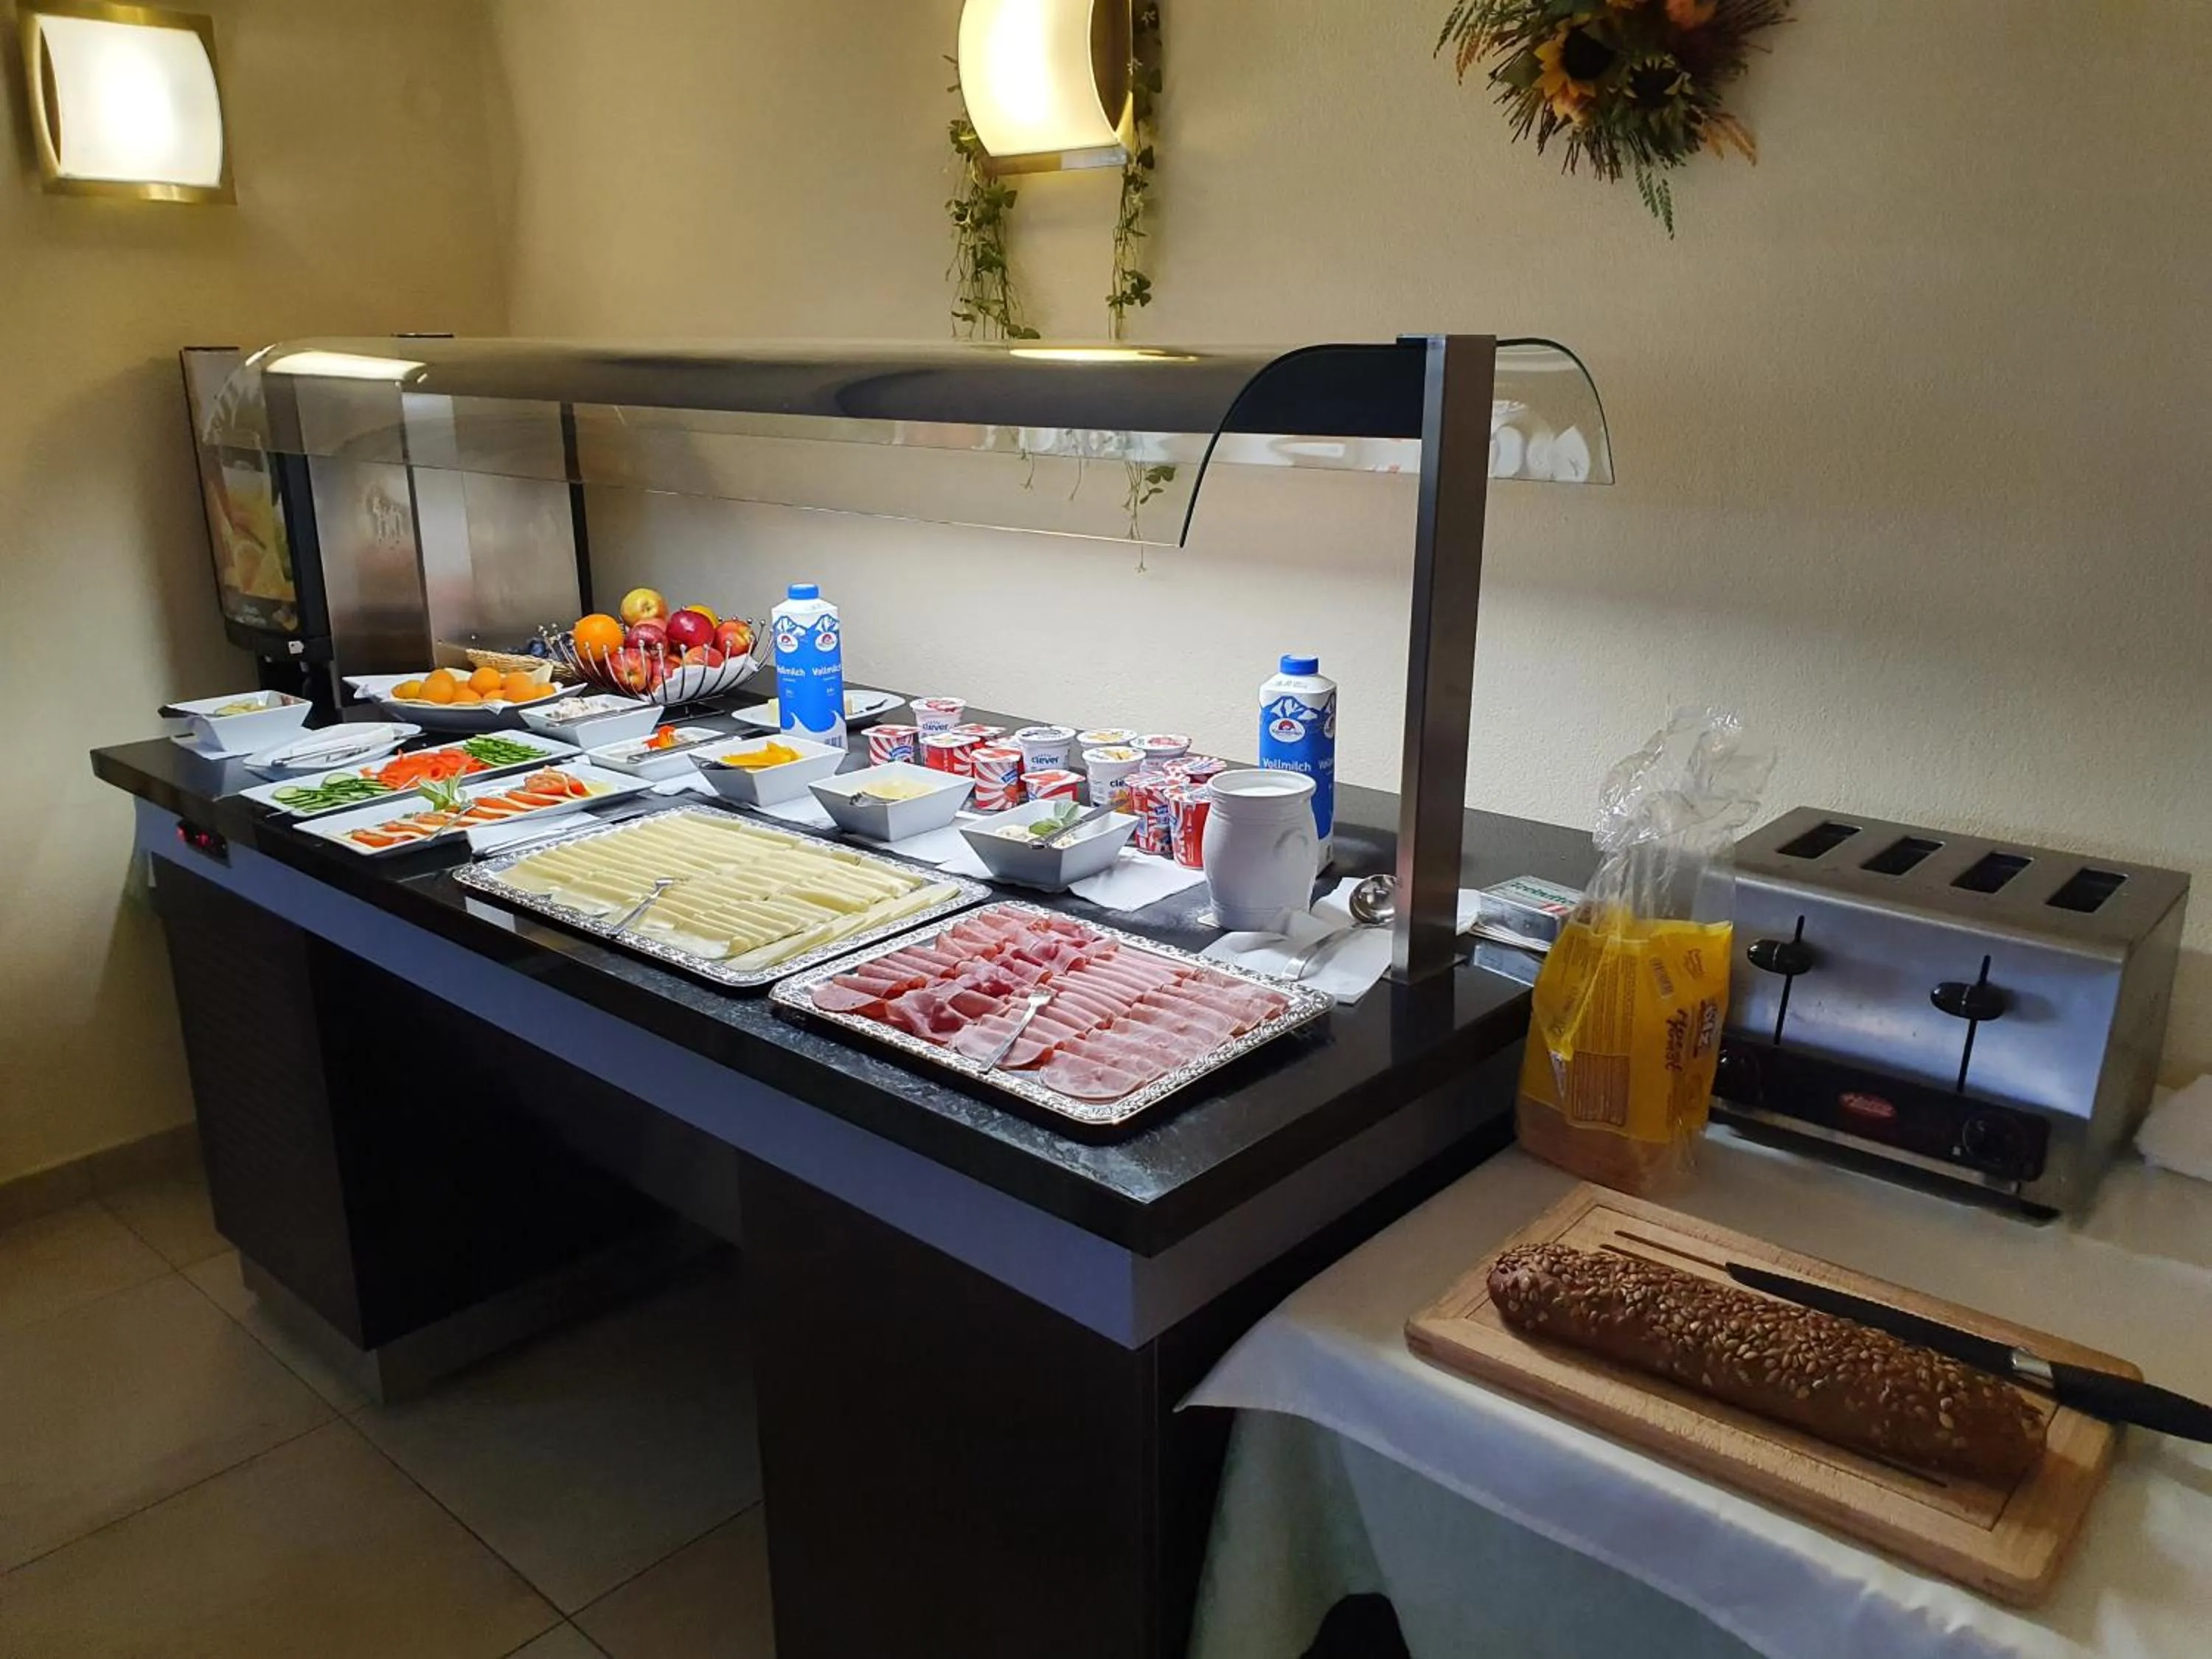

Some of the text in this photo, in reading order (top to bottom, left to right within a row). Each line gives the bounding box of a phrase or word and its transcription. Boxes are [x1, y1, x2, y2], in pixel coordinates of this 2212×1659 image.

[1032, 757, 1059, 765] clever
[1262, 757, 1312, 772] Vollmilch
[1110, 779, 1129, 787] cle
